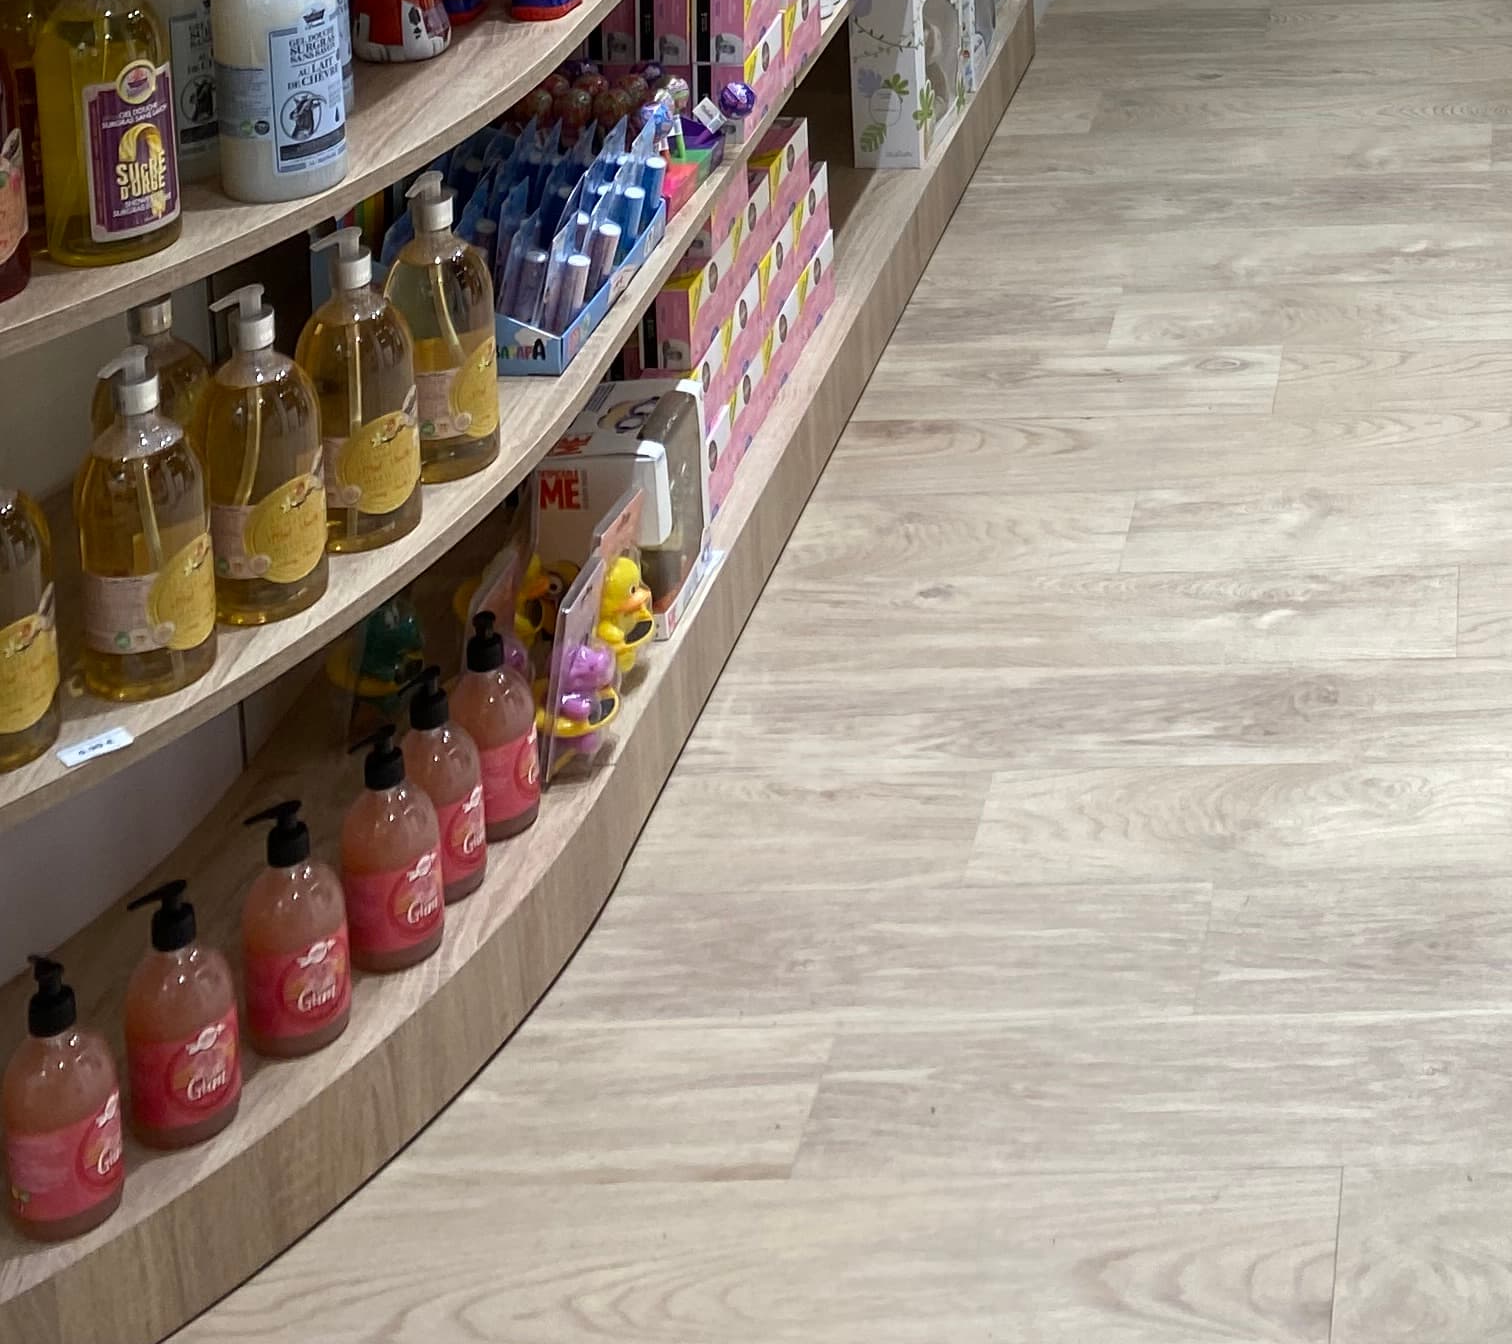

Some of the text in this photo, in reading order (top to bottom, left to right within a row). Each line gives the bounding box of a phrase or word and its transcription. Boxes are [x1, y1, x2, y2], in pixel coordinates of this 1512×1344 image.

[289, 37, 307, 49] GEL
[289, 34, 336, 56] SURGRAS
[297, 56, 334, 79] AU LAIT
[287, 79, 300, 91] DE
[116, 150, 166, 186] SUCRE
[120, 174, 166, 201] D'ORGE
[540, 479, 581, 510] ME
